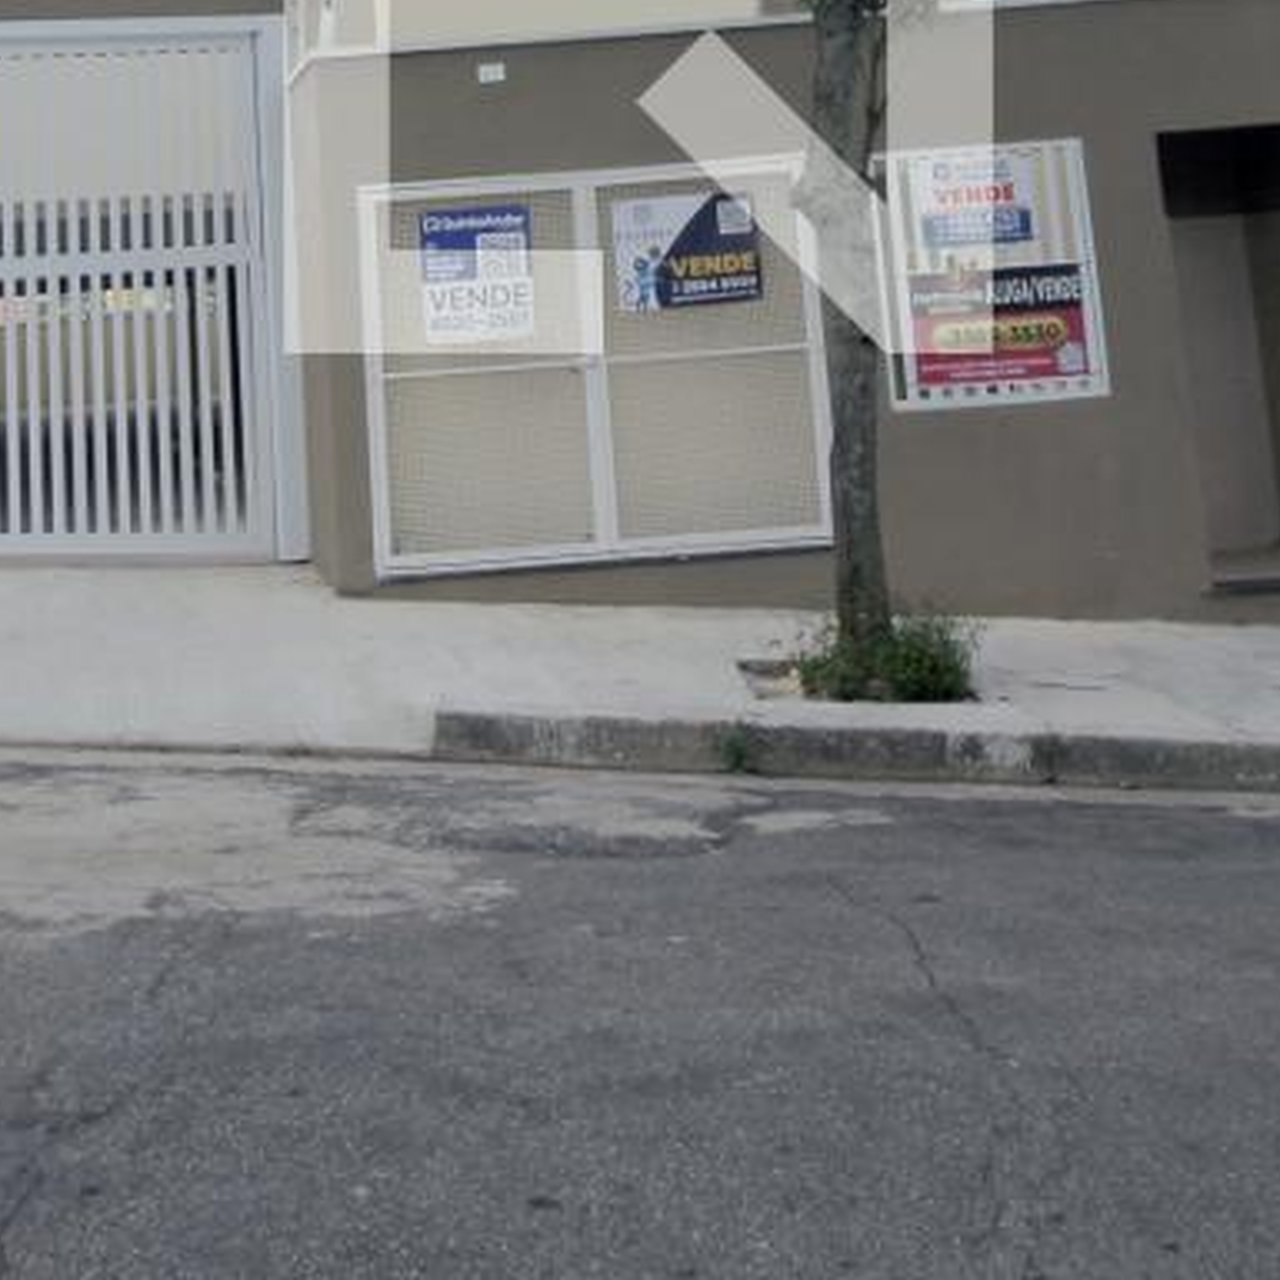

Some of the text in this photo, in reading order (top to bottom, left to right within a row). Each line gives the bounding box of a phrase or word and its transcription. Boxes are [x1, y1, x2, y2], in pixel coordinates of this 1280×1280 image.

[933, 181, 1015, 206] VENDE
[669, 250, 757, 279] VENDE
[428, 283, 529, 312] VENDE
